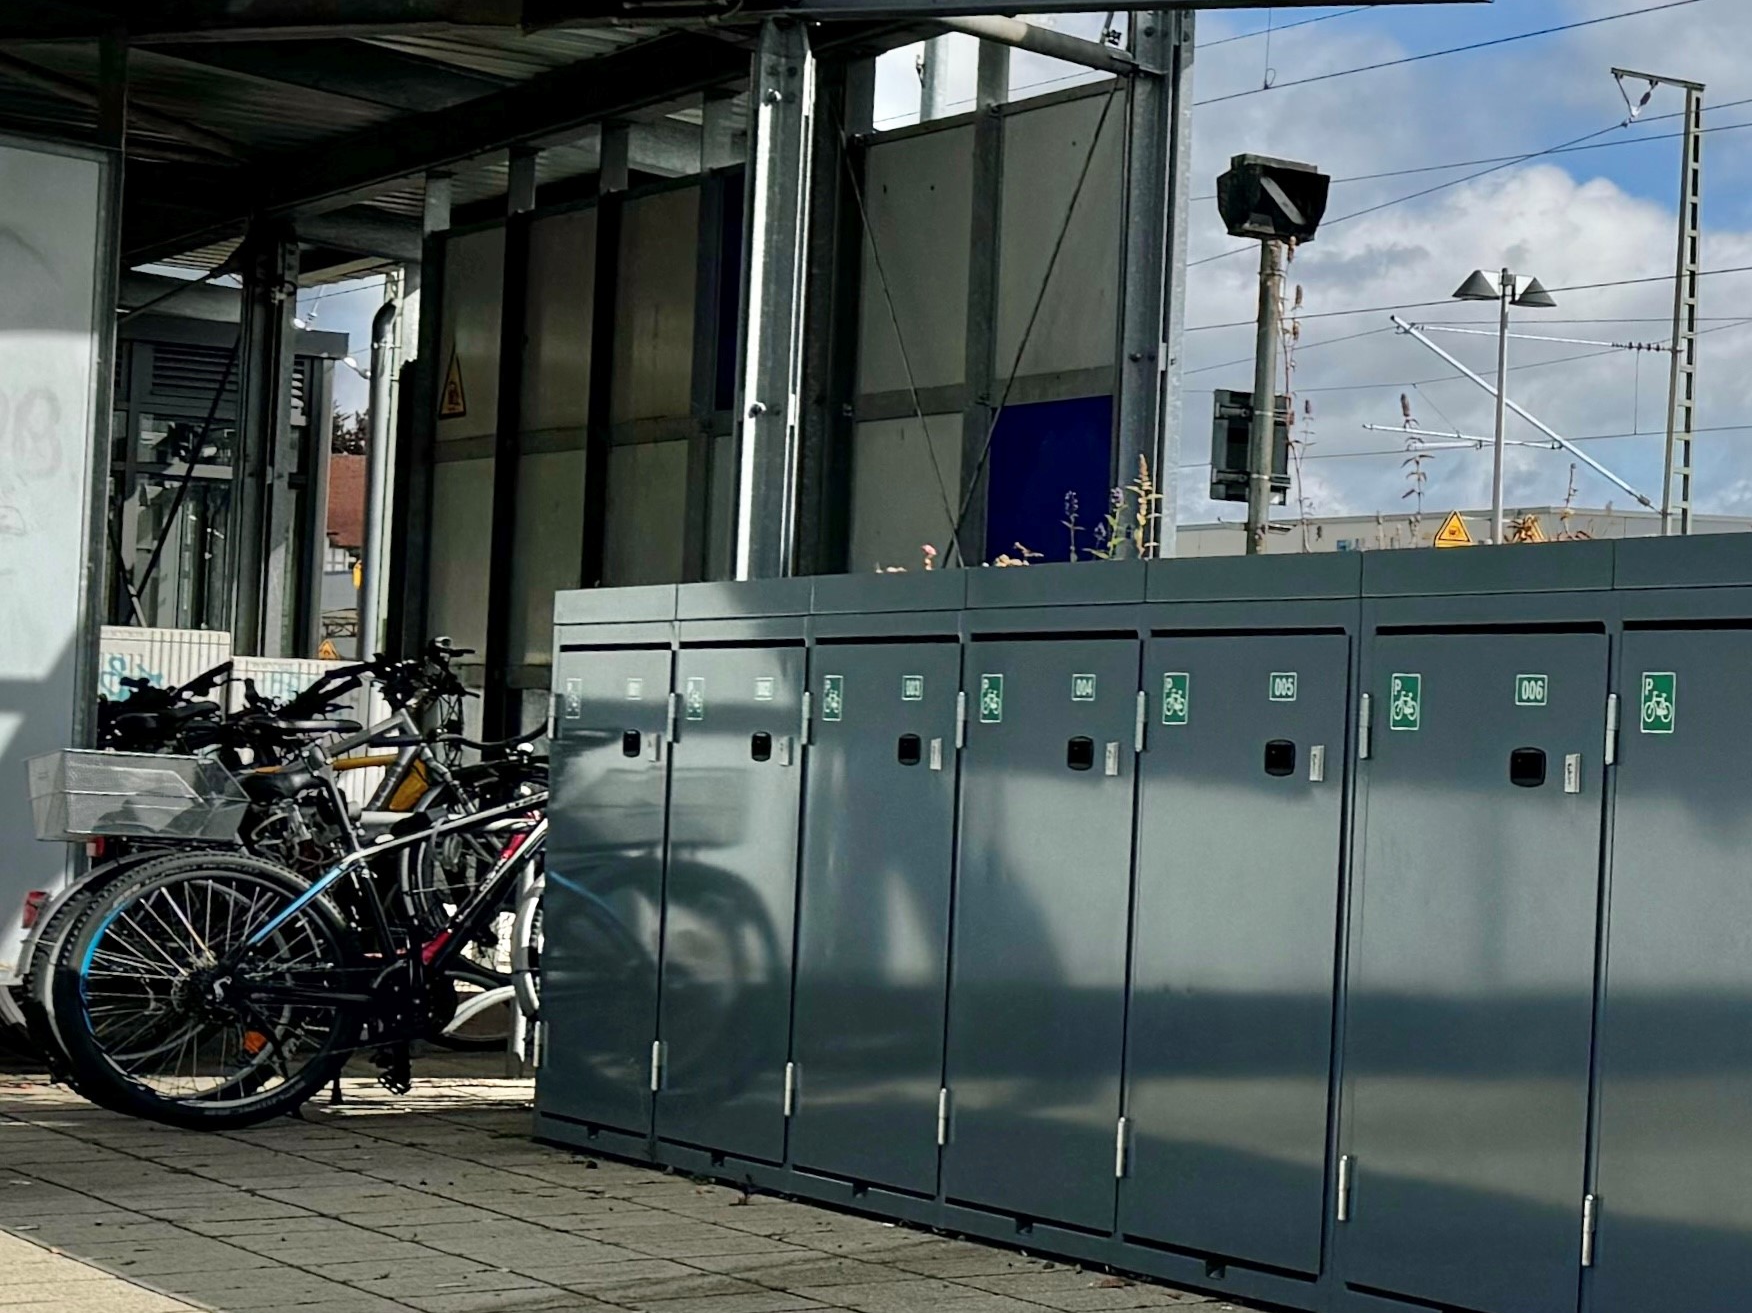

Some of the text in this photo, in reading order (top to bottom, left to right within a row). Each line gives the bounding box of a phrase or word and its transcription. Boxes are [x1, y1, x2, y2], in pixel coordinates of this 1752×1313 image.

[1274, 677, 1294, 696] 005
[1394, 678, 1402, 695] P
[1521, 680, 1544, 700] 006
[1645, 678, 1654, 695] P
